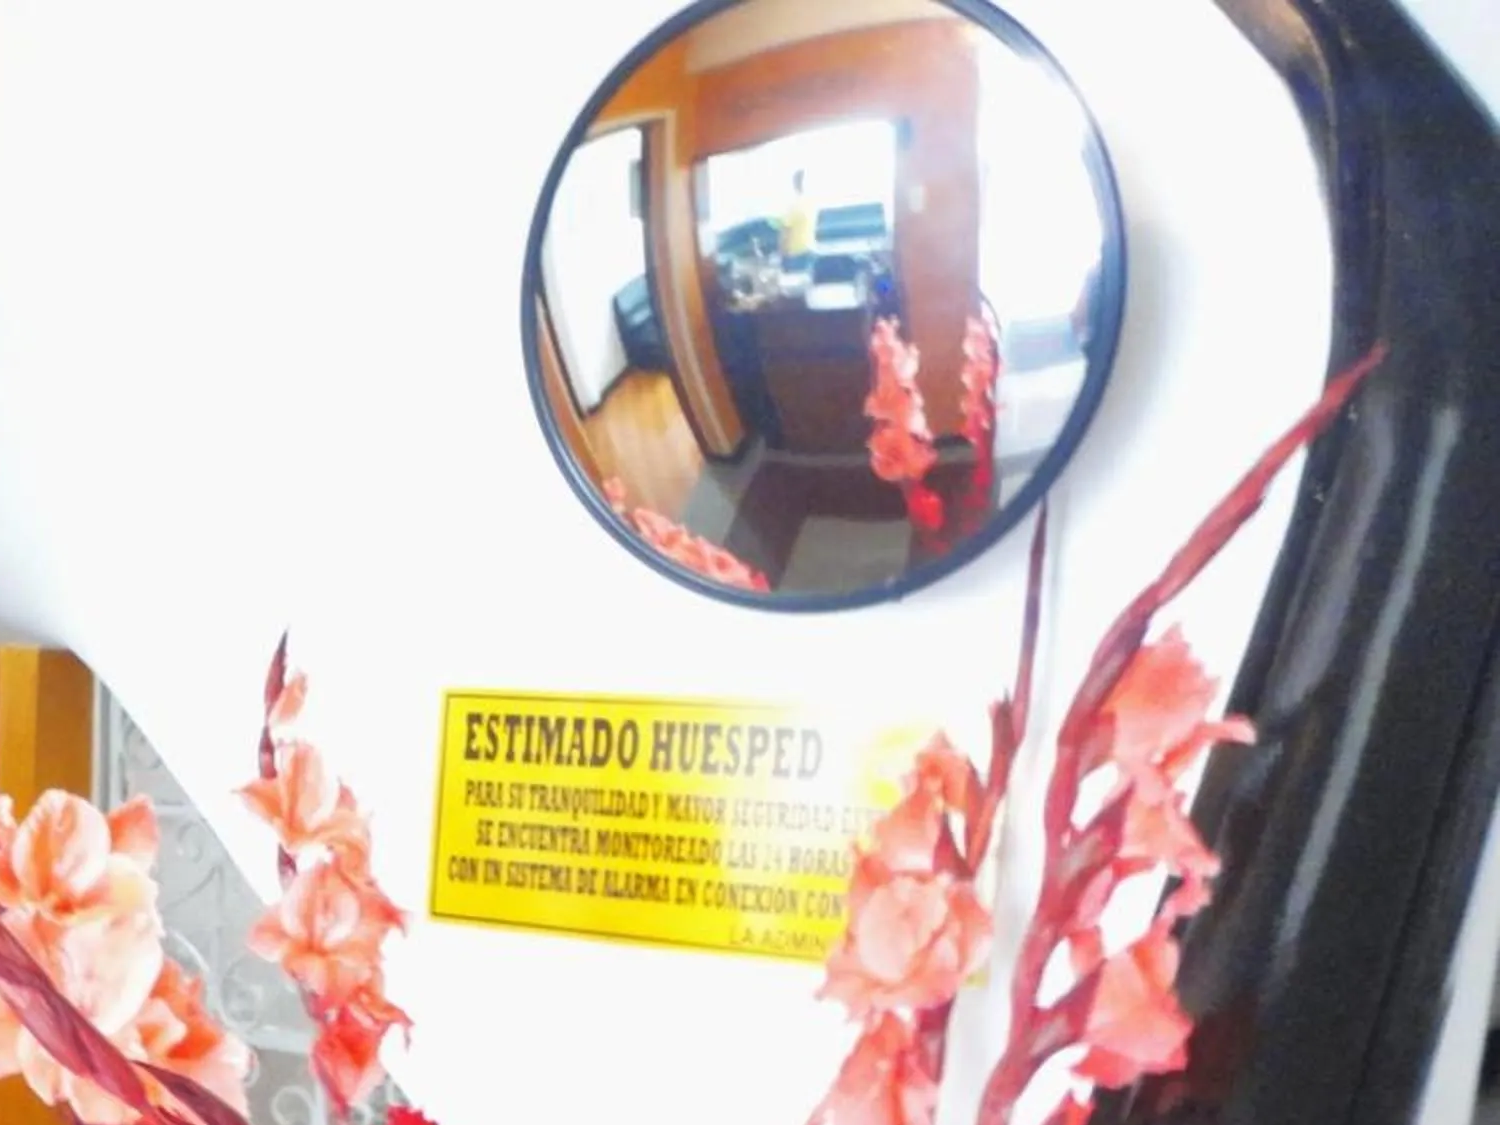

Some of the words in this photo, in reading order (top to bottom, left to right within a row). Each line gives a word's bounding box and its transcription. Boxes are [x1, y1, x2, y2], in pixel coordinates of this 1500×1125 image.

[464, 711, 640, 770] ESTIMADO
[649, 719, 825, 781] HUESPED
[465, 779, 504, 808] PARA
[508, 782, 525, 810] SU
[529, 782, 649, 821] TRANQUILIDAD
[651, 791, 662, 820] Y
[666, 792, 727, 825] MAYOR
[731, 797, 836, 833] SEGURIDAD
[476, 818, 494, 847] SE
[497, 820, 592, 857] ENCUENTRA
[594, 827, 723, 868] MONITOREADO
[727, 839, 758, 870] LAS
[788, 846, 851, 878] HORAS
[448, 854, 480, 884] CON
[483, 857, 503, 886] UN
[506, 860, 573, 895] SISTEMA
[577, 867, 599, 896] DE
[602, 868, 671, 903] ALARMA
[676, 877, 699, 907] EN
[702, 879, 799, 916] CONEXION
[804, 889, 843, 920] CON
[728, 926, 758, 947] LA
